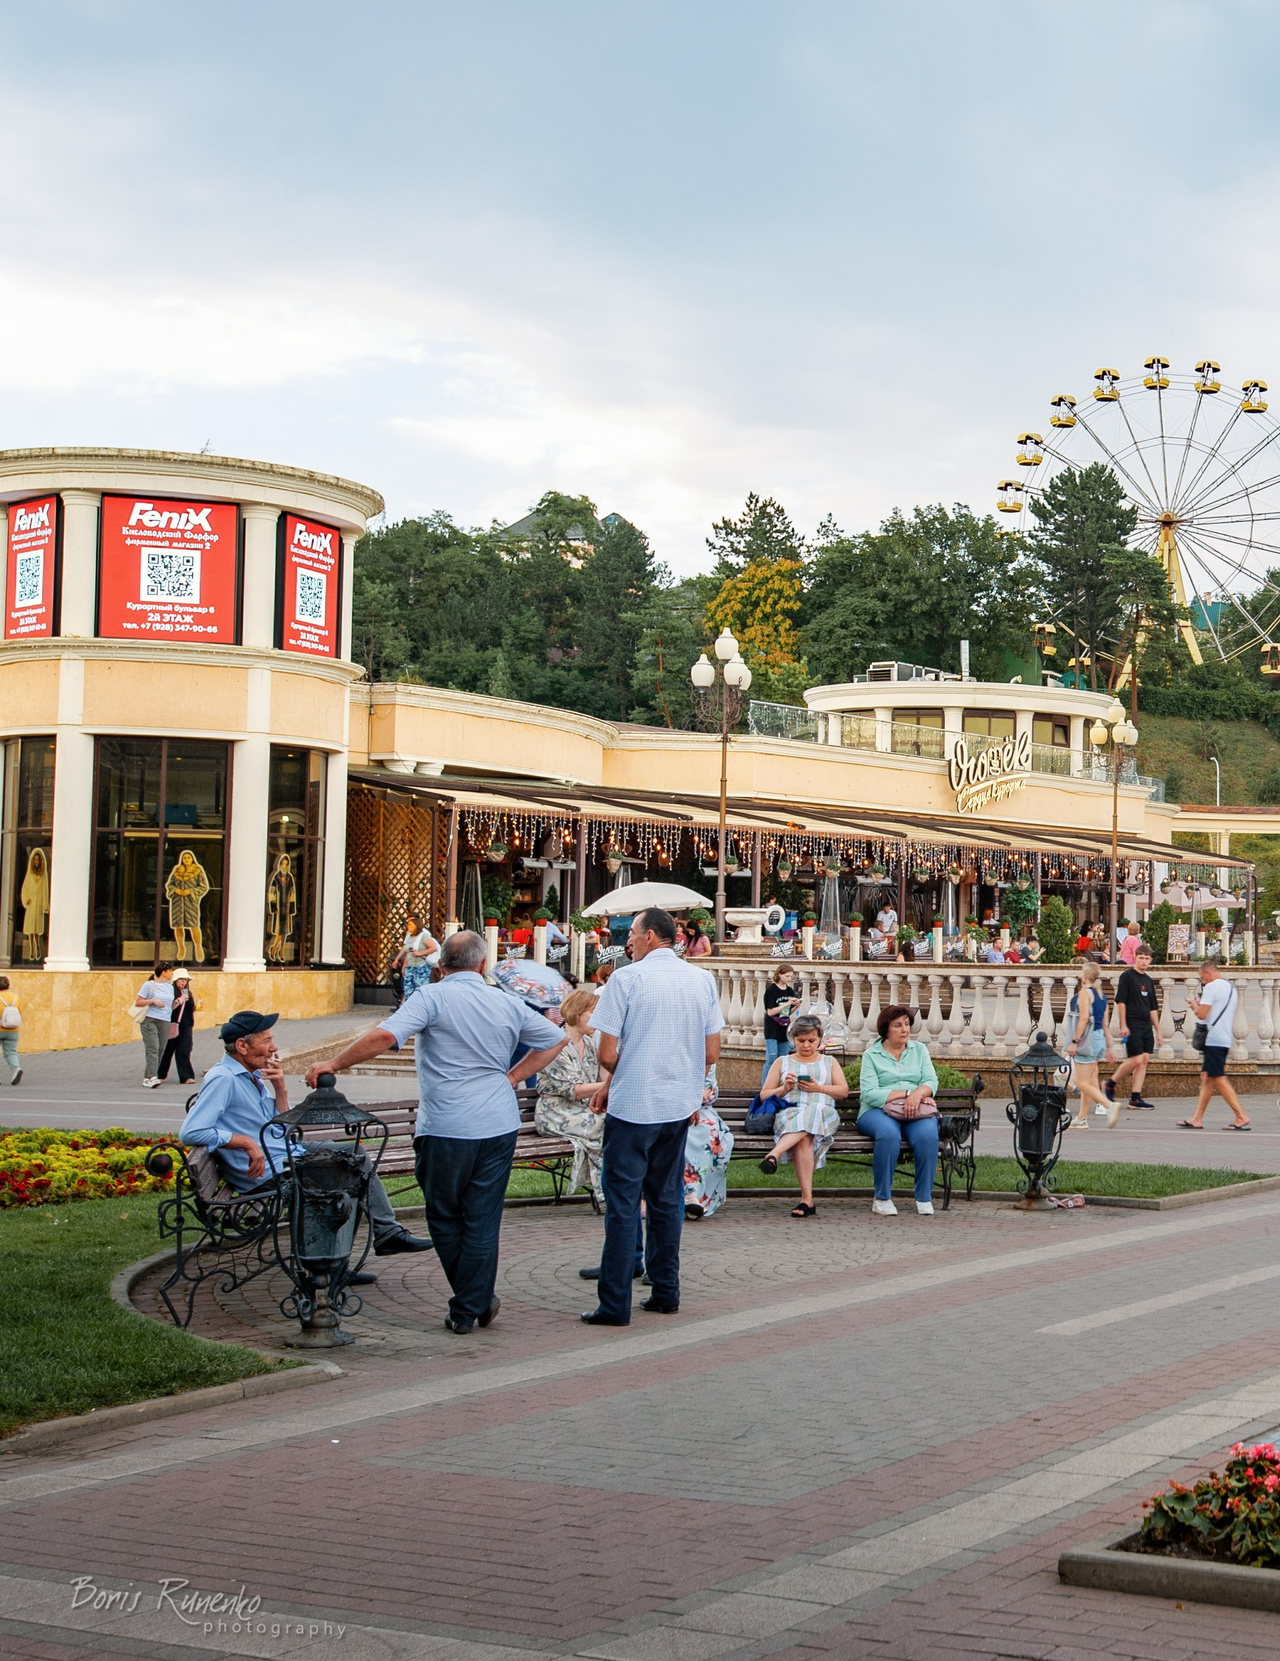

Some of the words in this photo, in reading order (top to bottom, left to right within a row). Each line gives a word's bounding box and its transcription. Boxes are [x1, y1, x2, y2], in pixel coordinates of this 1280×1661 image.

[184, 530, 219, 542] Фарфор
[126, 602, 173, 611] Курортный
[174, 604, 208, 614] бульвар
[147, 612, 161, 621] 2й
[162, 613, 194, 623] ЭТАЖ
